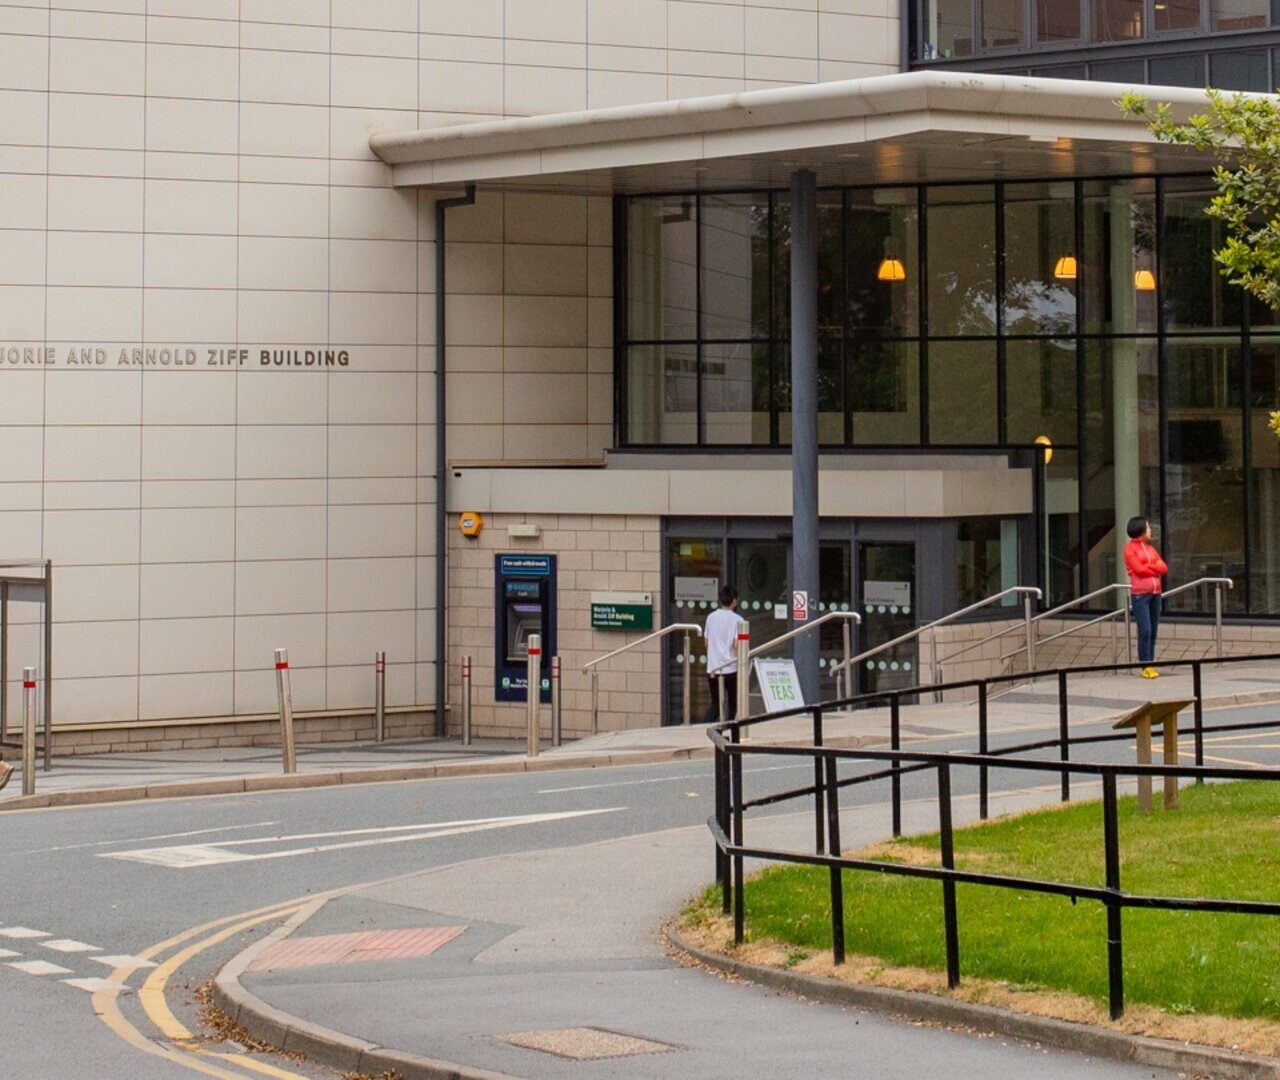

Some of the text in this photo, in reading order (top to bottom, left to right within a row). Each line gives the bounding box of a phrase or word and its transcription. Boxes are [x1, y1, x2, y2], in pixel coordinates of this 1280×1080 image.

[66, 346, 108, 366] AND
[118, 347, 198, 367] ARNOLD
[206, 348, 250, 367] ZIFF
[259, 349, 351, 368] BUILDING
[770, 685, 796, 701] TEAS
